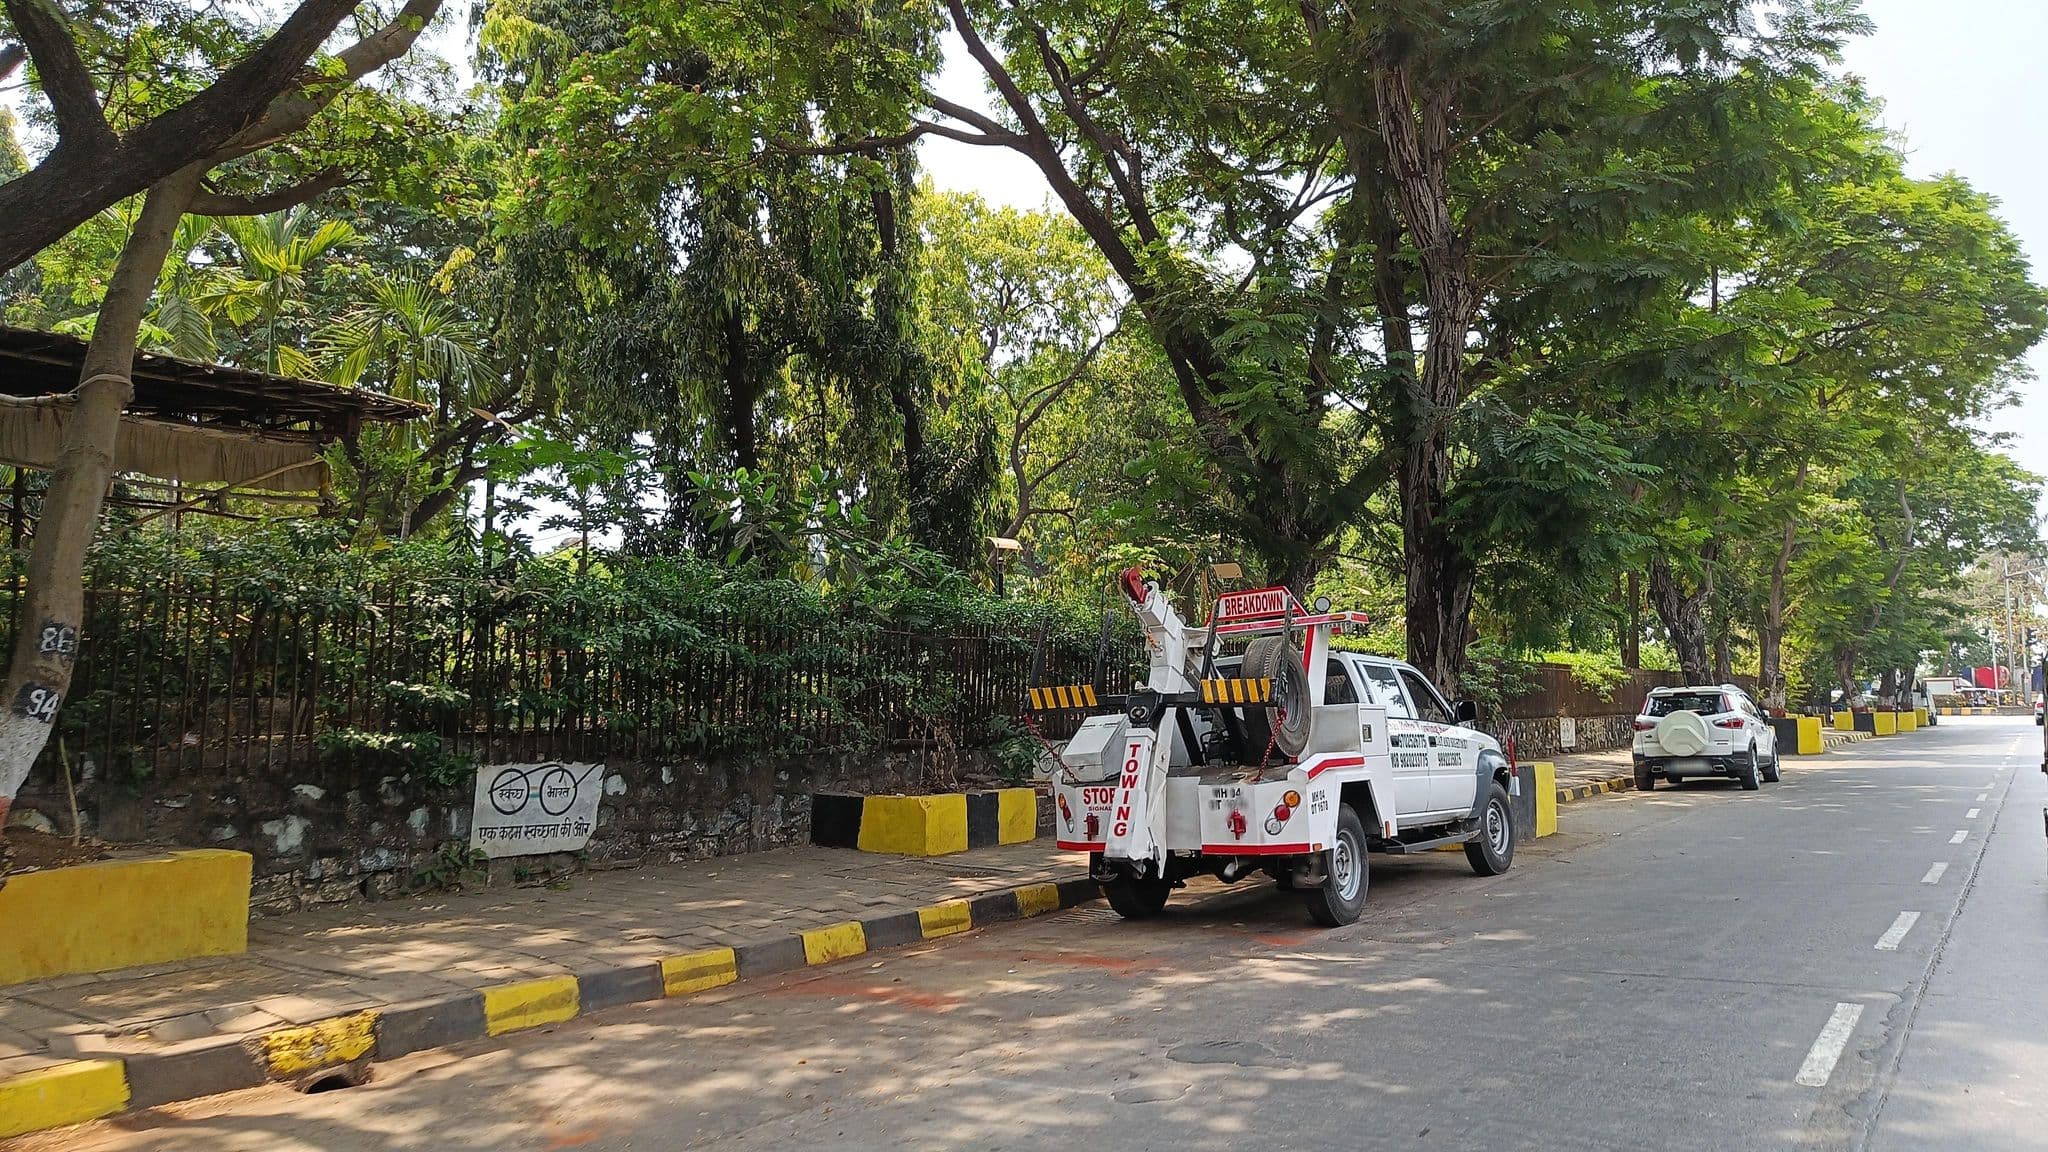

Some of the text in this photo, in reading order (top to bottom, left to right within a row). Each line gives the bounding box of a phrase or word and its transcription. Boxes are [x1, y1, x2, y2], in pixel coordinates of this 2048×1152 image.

[1225, 592, 1284, 616] BREAKDOWN
[26, 688, 60, 723] 94
[498, 785, 571, 802] स्वच्छ भारत
[1083, 787, 1116, 805] STOP
[1113, 743, 1141, 837] TOWING
[478, 816, 591, 844] एक कदम स्वच्छता की ओर
